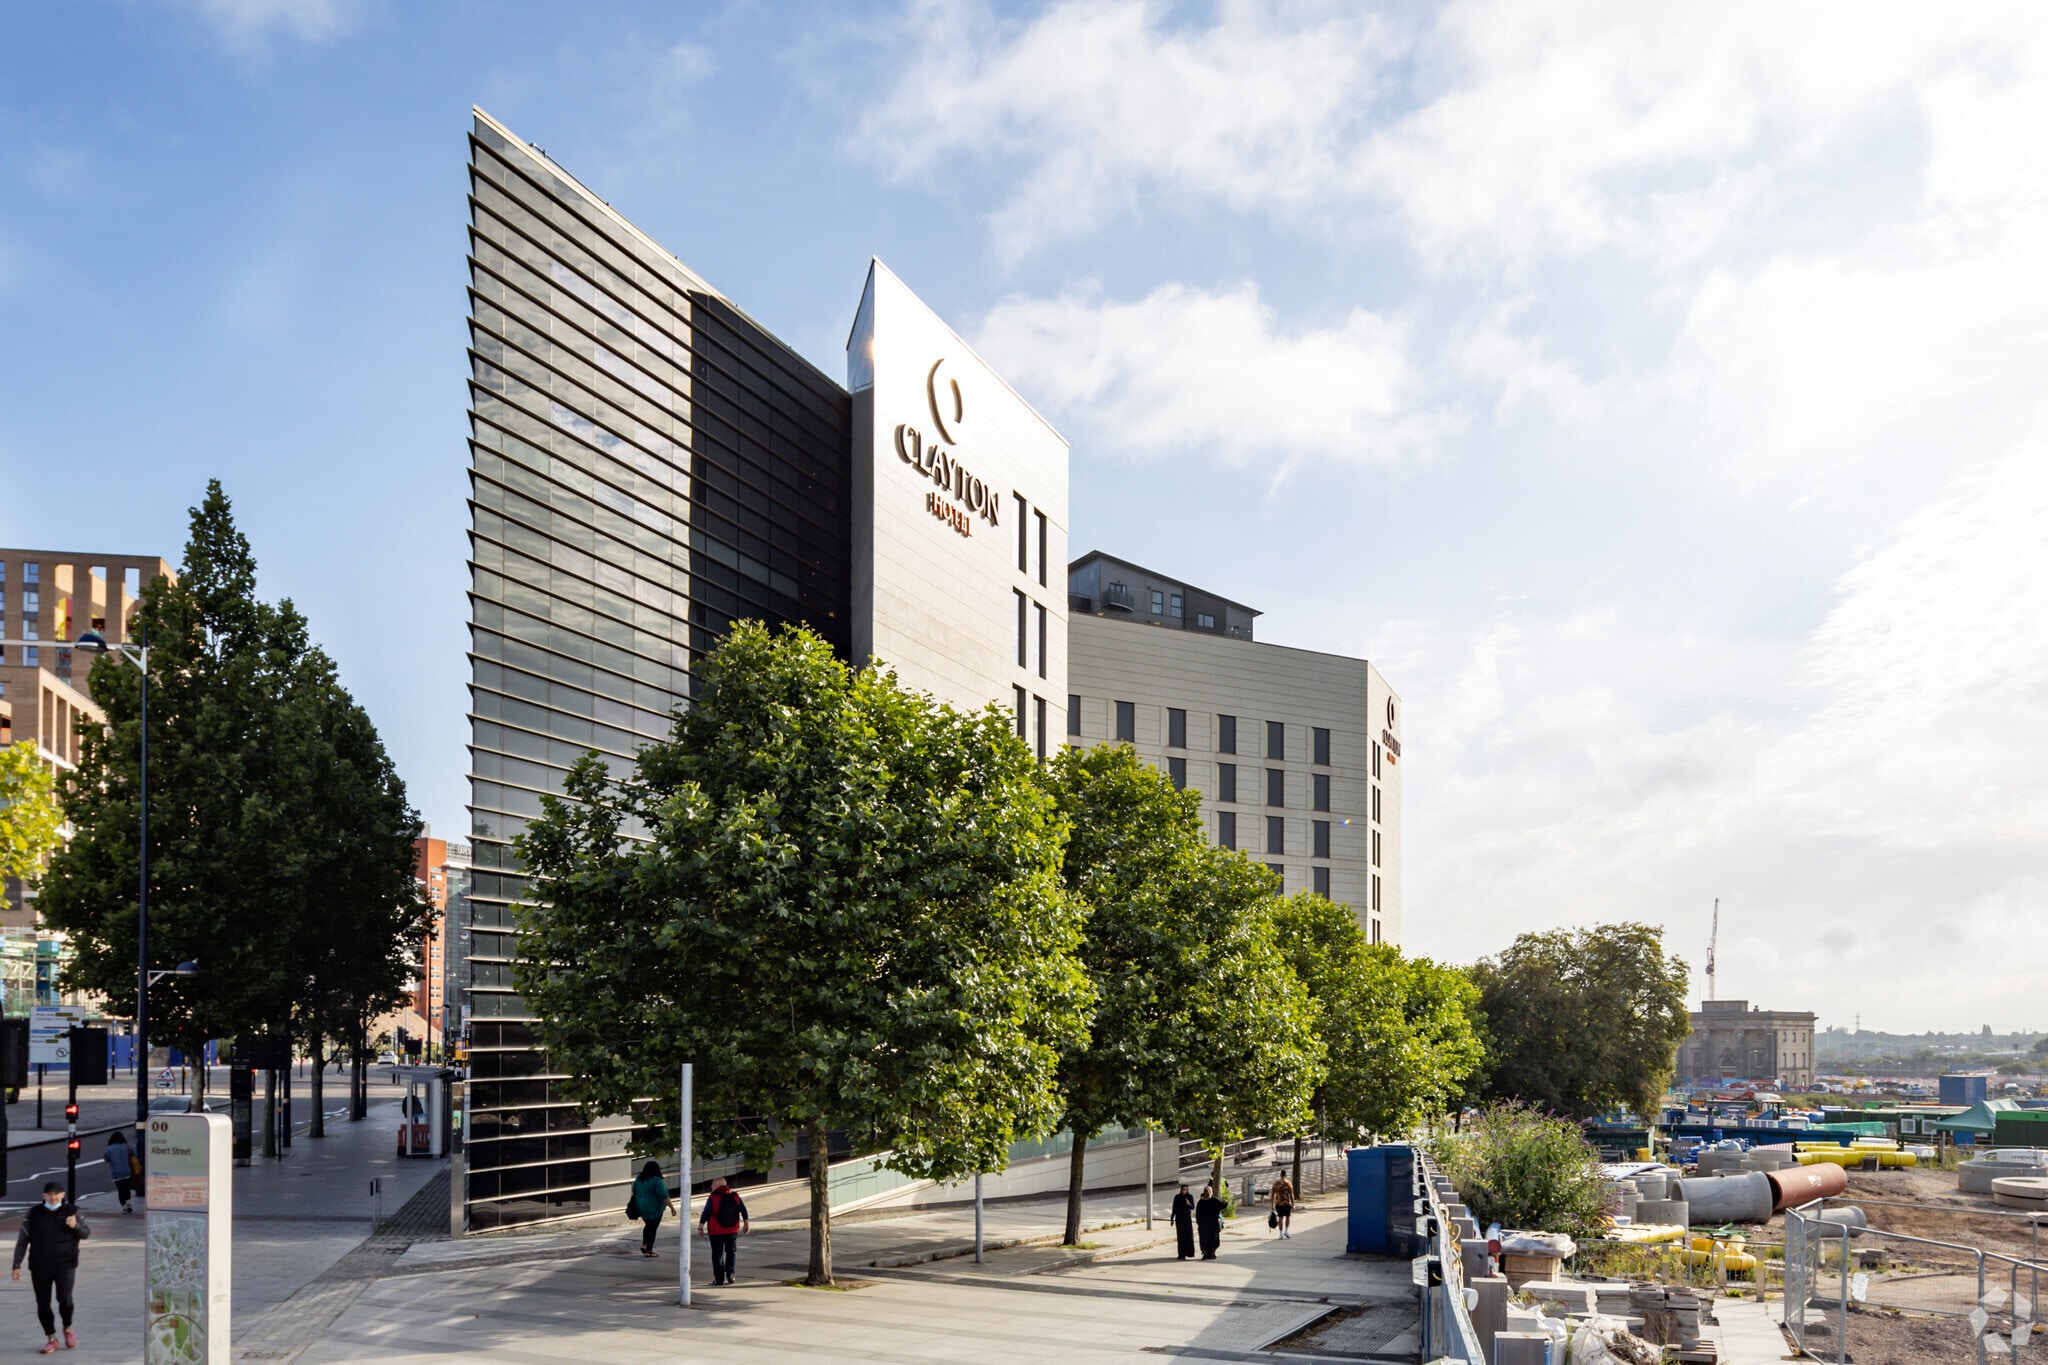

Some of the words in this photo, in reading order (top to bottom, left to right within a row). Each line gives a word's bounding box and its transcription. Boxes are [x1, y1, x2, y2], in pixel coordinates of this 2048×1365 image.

[894, 423, 999, 528] CLAYTON
[926, 491, 973, 538] HOTEL
[151, 1146, 171, 1155] Albert
[172, 1147, 191, 1156] Street
